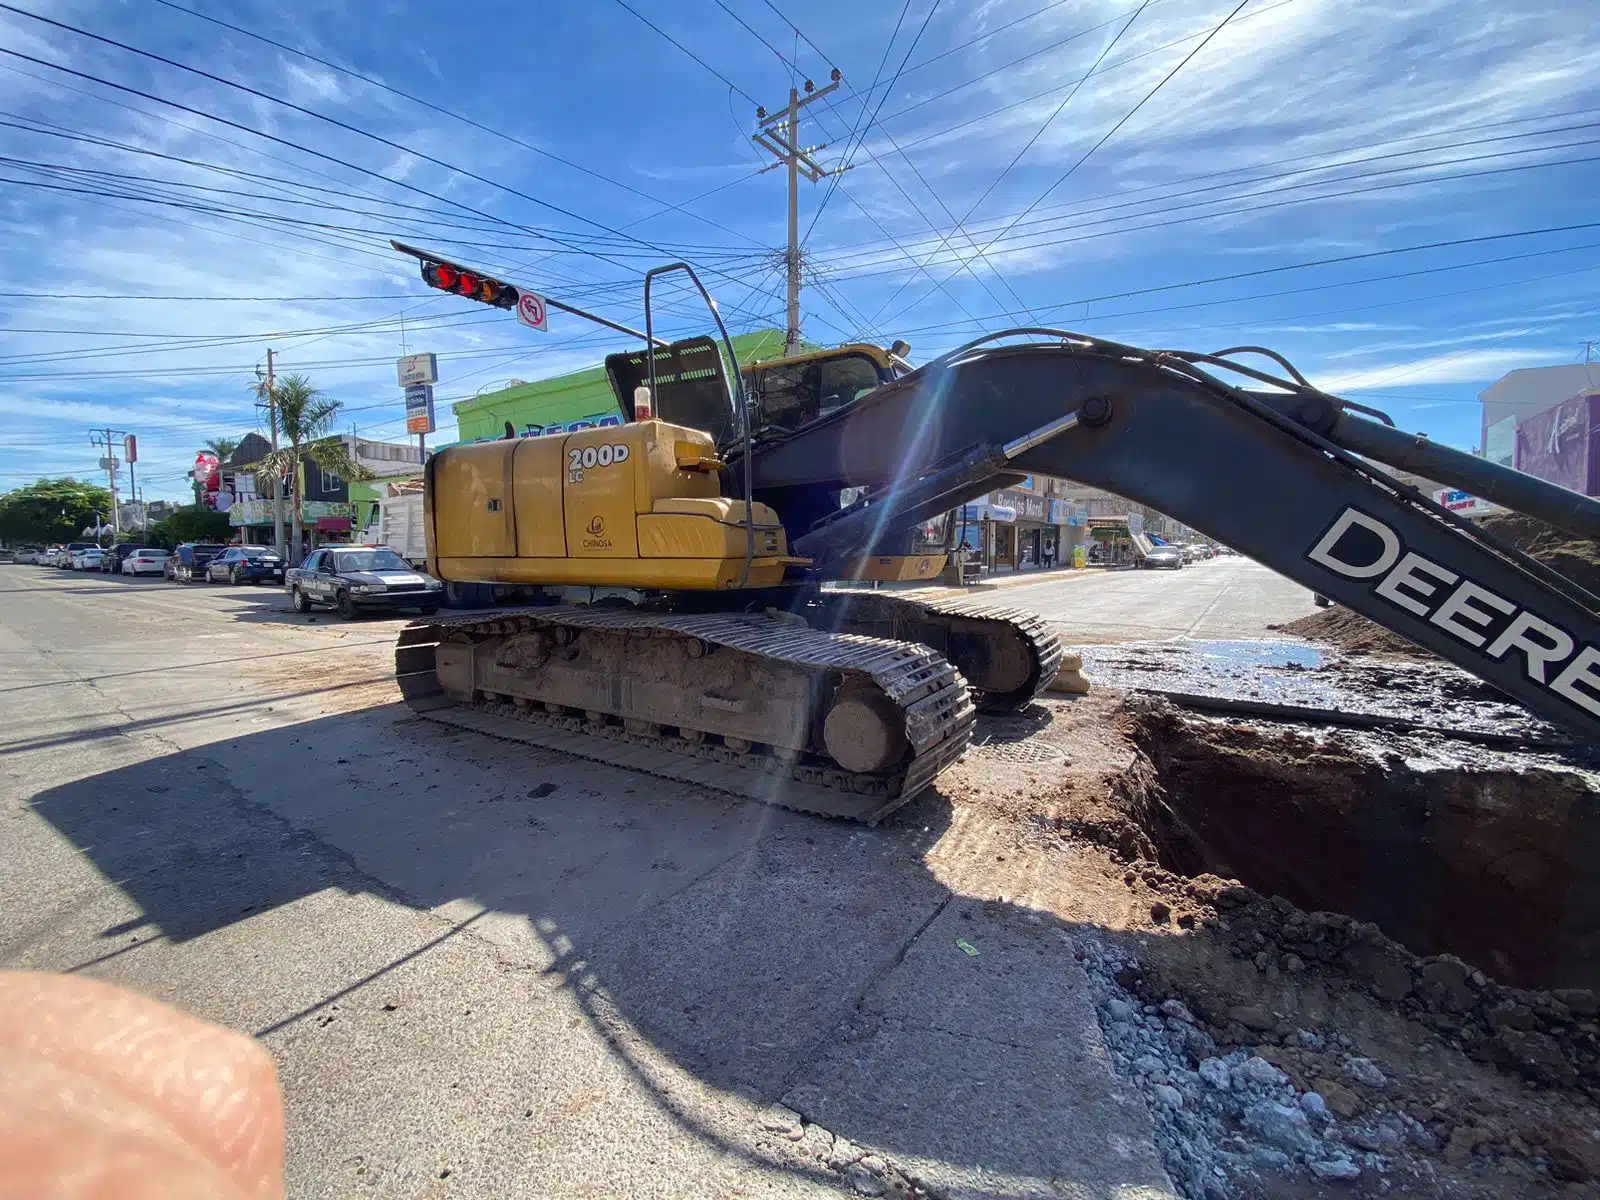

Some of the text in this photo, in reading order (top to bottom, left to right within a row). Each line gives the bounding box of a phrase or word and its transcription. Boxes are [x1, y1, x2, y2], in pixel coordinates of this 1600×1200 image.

[568, 444, 629, 470] 200D
[568, 470, 584, 483] LC
[1308, 507, 1600, 718] DEERE
